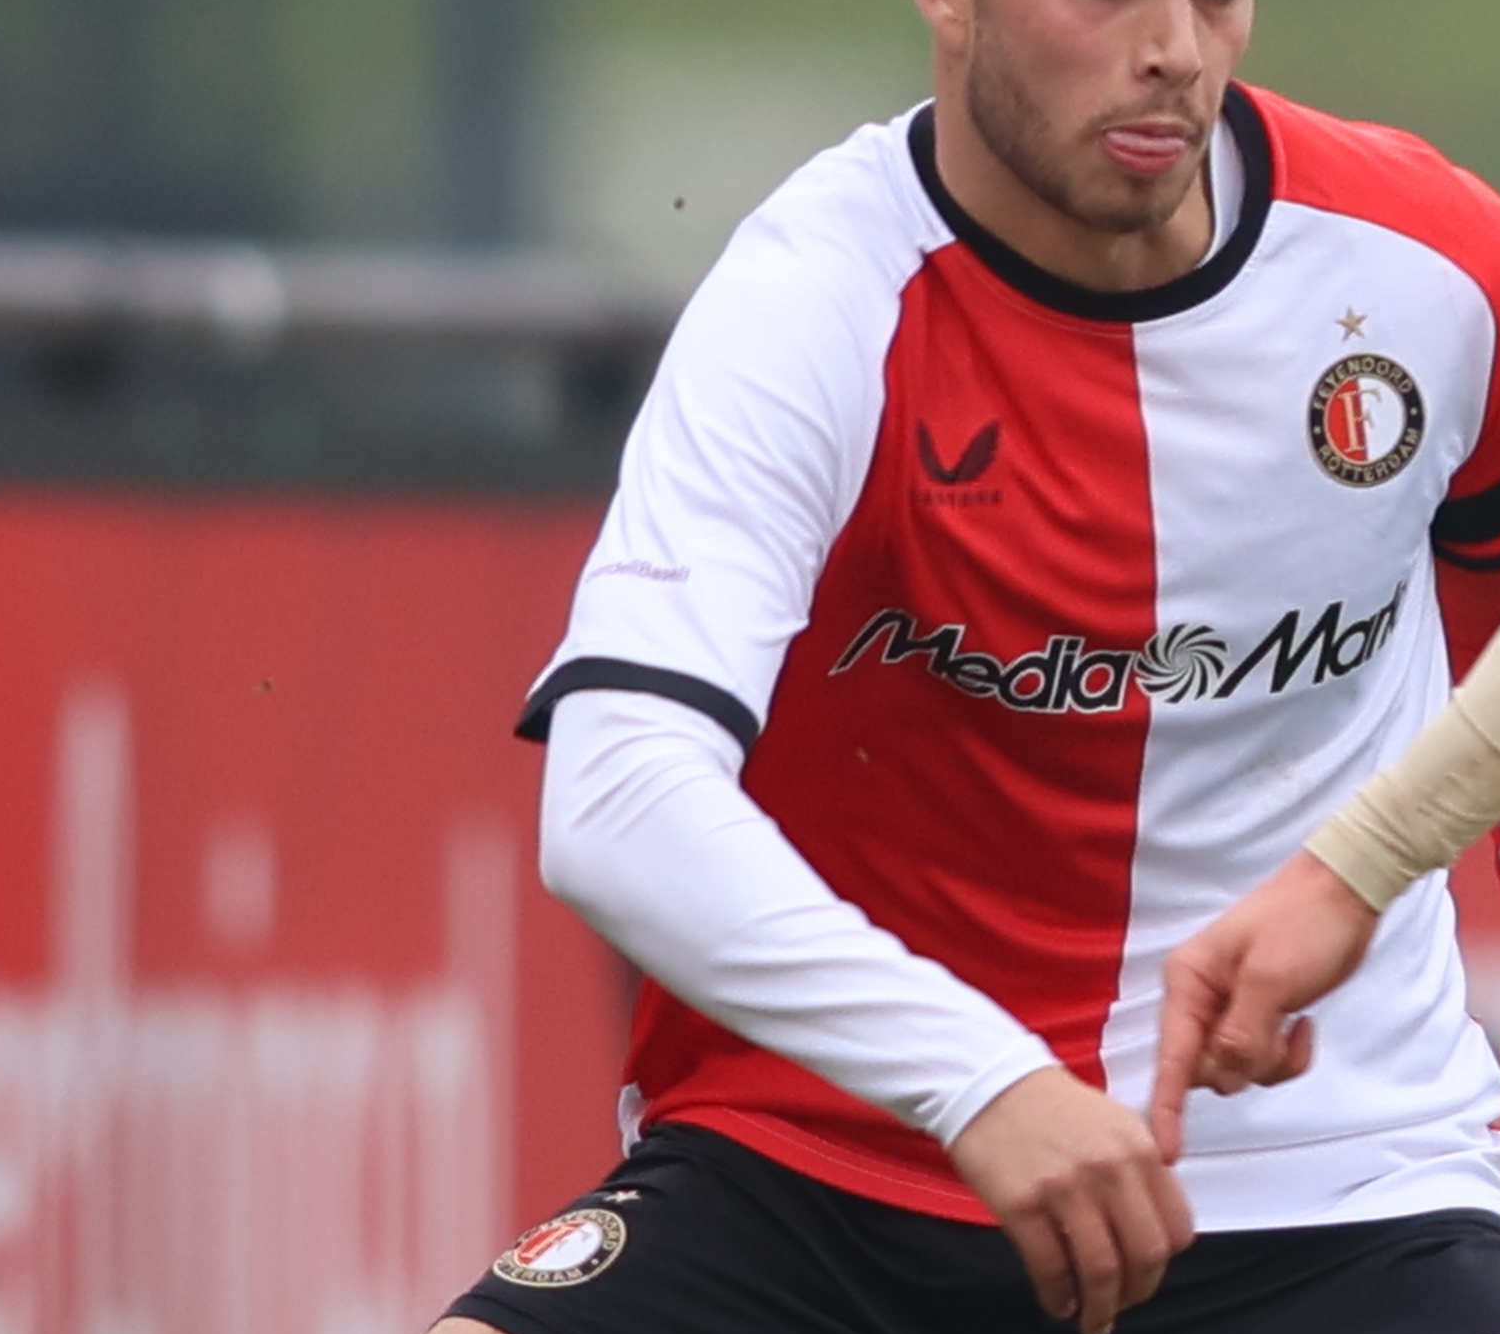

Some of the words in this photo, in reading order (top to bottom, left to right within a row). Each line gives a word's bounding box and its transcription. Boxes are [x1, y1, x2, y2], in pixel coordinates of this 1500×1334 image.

[1312, 355, 1414, 411] FEYENOORD
[1318, 427, 1421, 483] ROTTERDAM
[828, 607, 1137, 715] Media
